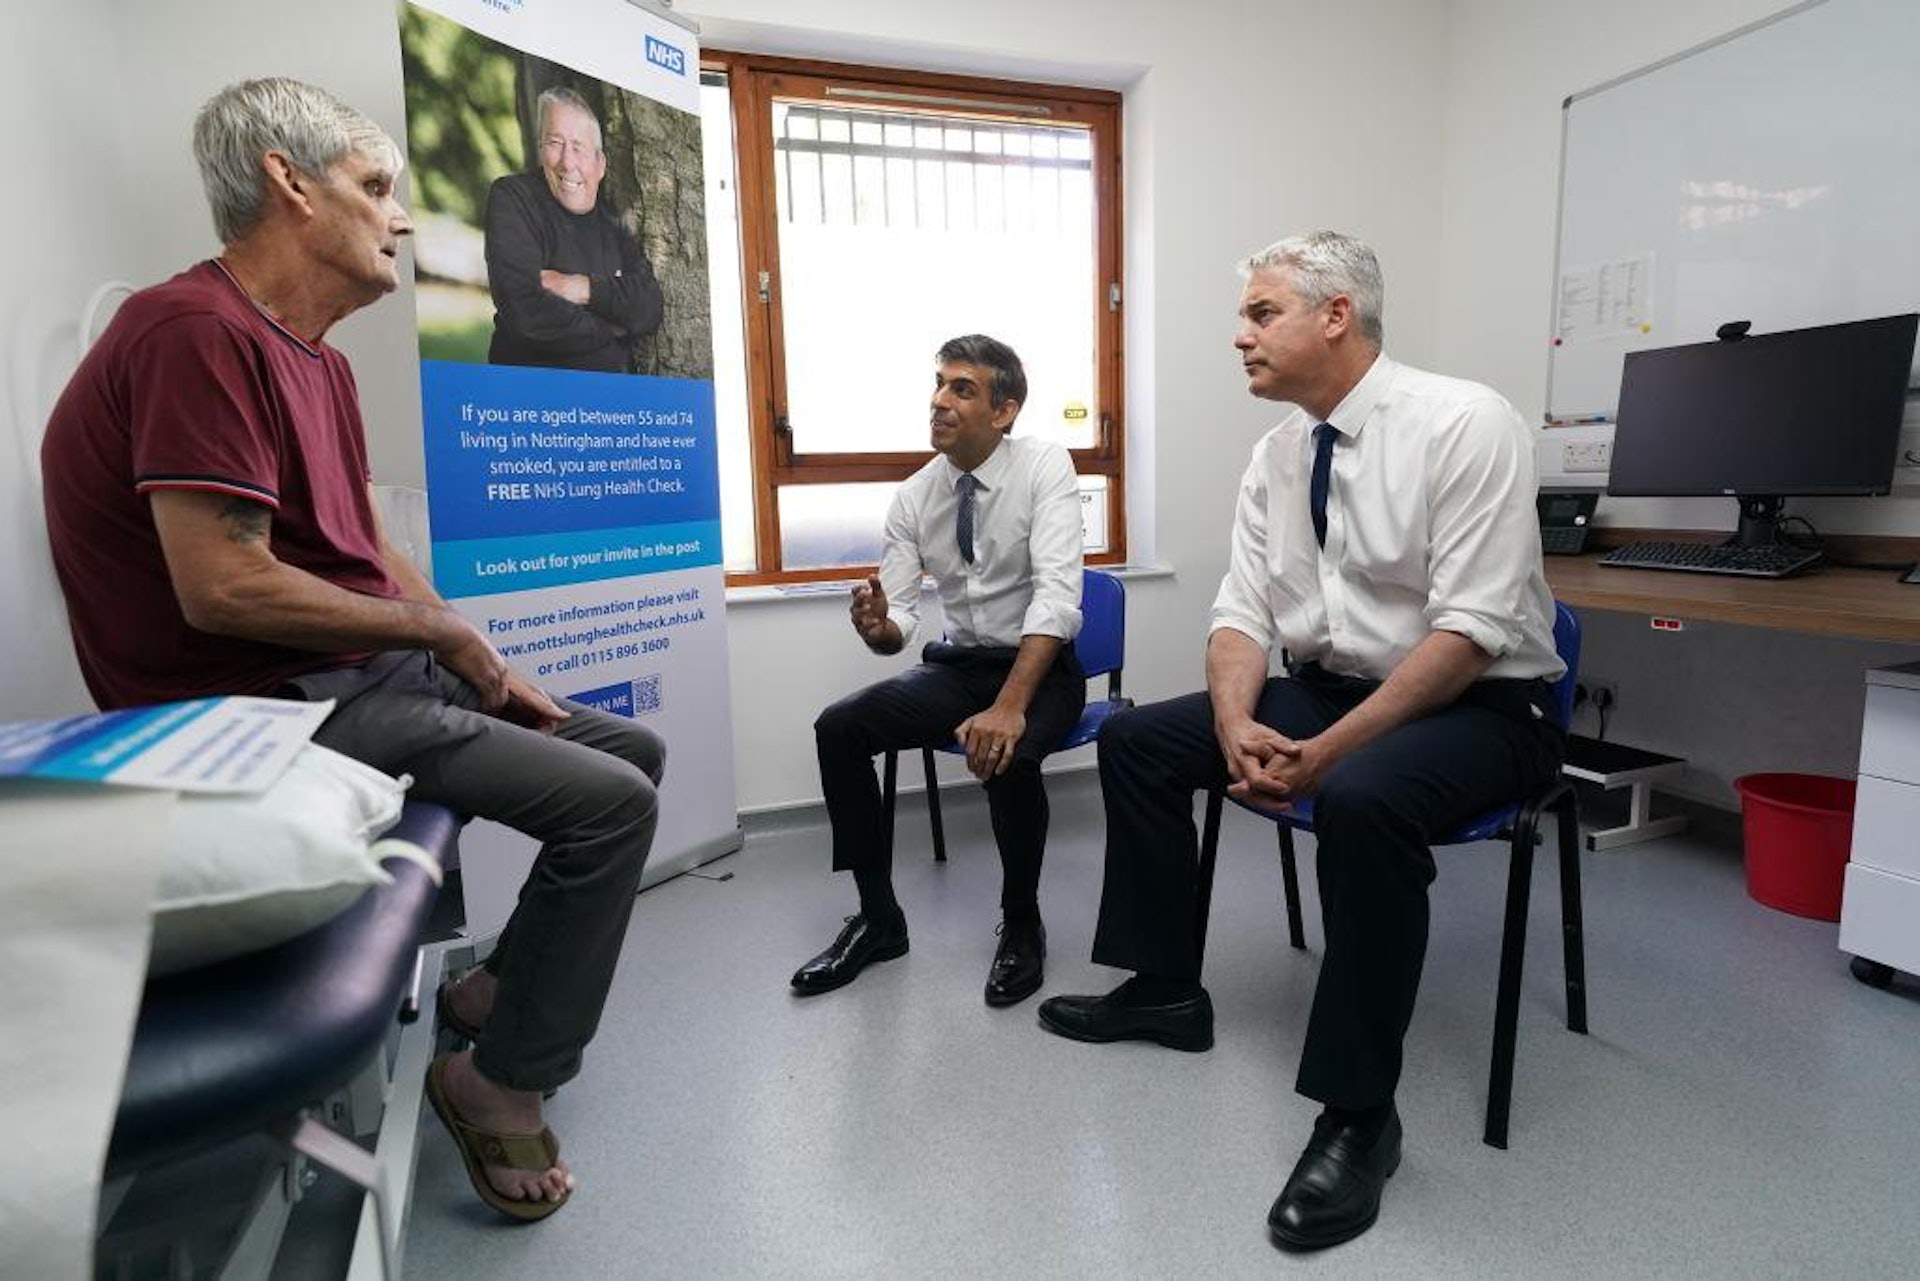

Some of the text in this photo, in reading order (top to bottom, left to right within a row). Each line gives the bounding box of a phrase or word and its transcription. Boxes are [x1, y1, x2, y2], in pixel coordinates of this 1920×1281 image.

[648, 44, 683, 72] NHS
[462, 404, 693, 427] If you are aged between 55 and 74
[461, 431, 696, 453] living in Nottingham and have ever
[490, 456, 682, 477] smoked, you are entitled to a
[488, 478, 684, 500] FREE NHS Lung Health Check.
[477, 540, 700, 576] Look out for your invite in the post
[489, 588, 699, 634] For more information please visit
[538, 637, 670, 676] or call 0115 896 3600
[612, 694, 628, 708] ME
